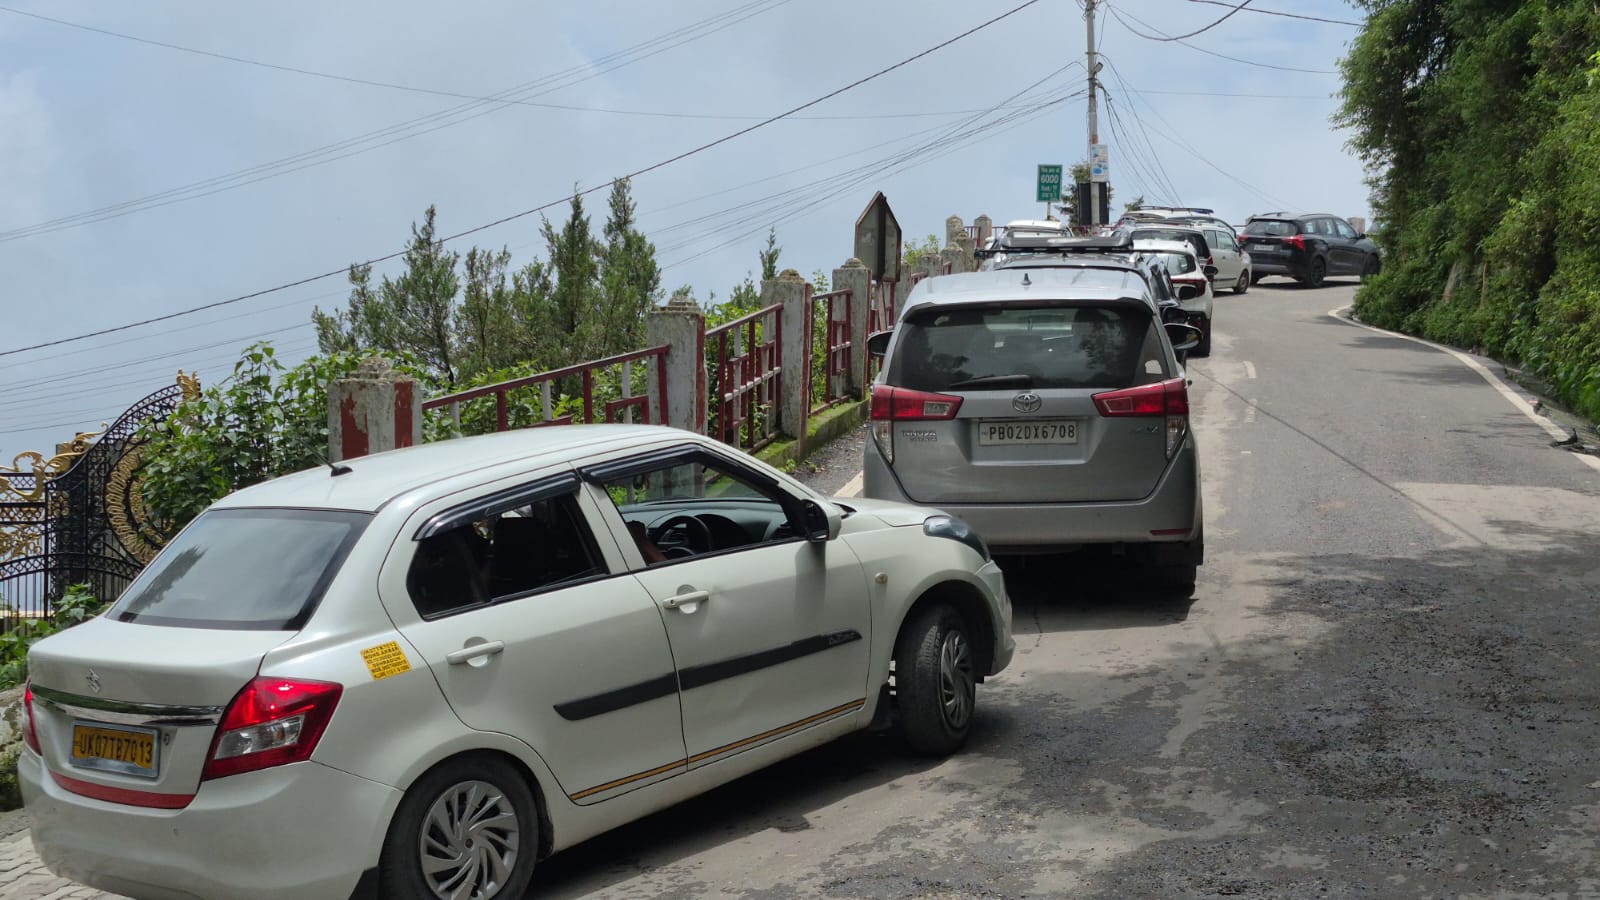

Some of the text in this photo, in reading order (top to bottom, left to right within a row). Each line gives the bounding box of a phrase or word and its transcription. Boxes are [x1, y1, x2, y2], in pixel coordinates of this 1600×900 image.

[1041, 174, 1059, 184] 6000
[989, 424, 1075, 440] PB02DX6708
[80, 733, 153, 763] UK07TB7013
